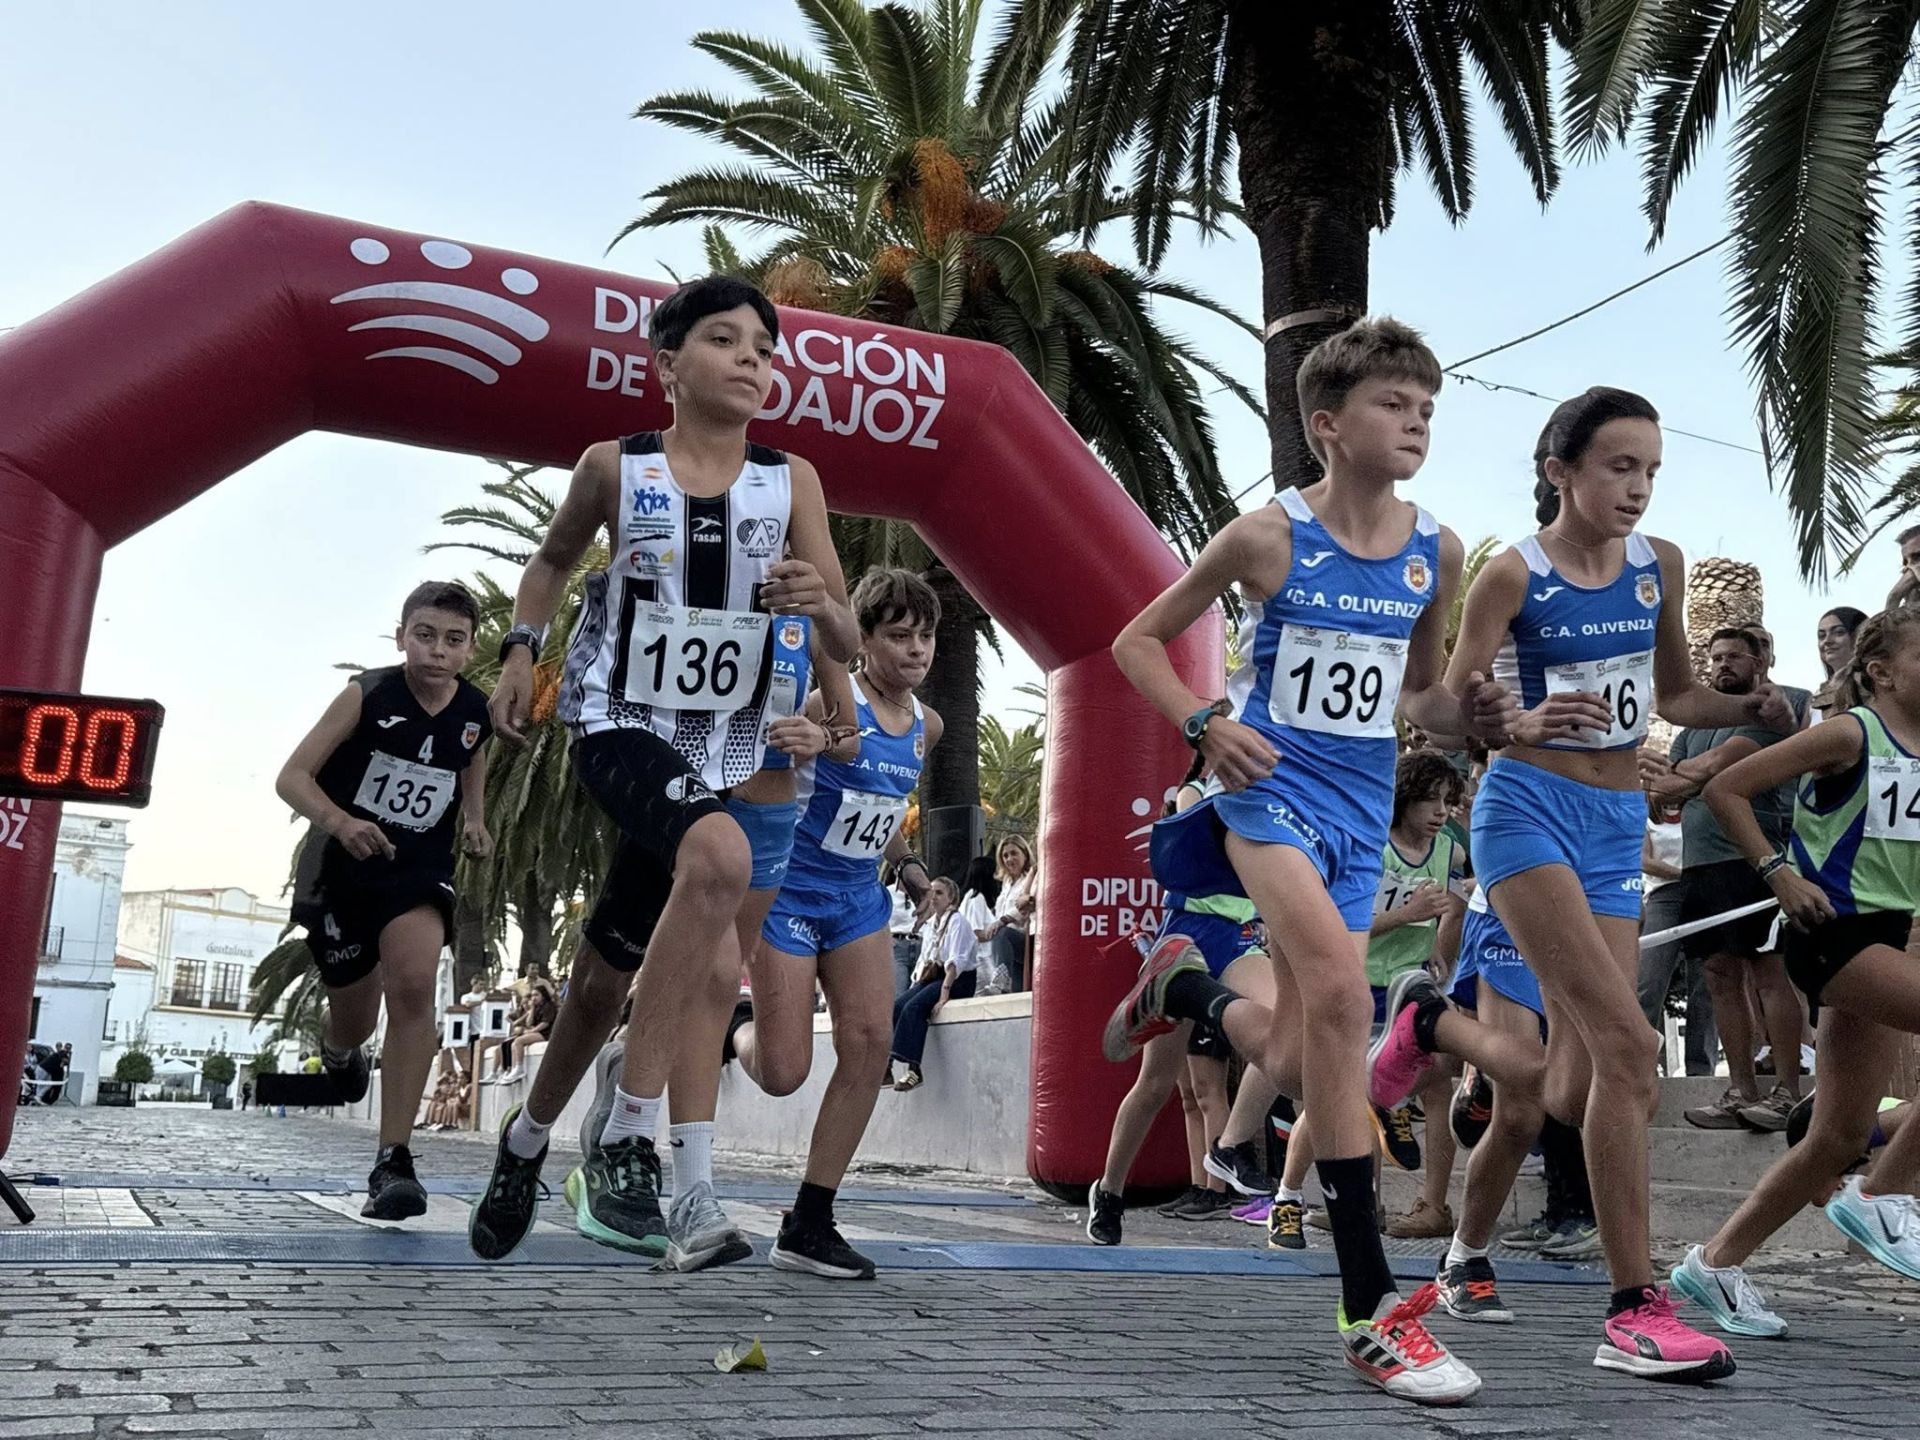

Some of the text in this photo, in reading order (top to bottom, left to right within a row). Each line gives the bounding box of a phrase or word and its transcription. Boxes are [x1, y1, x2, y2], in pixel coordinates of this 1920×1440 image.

[586, 347, 945, 451] DE DAJOZ
[1540, 618, 1655, 638] C.A. OLIVENZA
[643, 634, 742, 696] 136
[1290, 656, 1383, 723] 139
[21, 704, 136, 789] 00
[418, 735, 434, 764] 4
[373, 772, 438, 819] 135
[844, 810, 894, 850] 143
[324, 912, 341, 941] 4
[1081, 914, 1108, 936] DE
